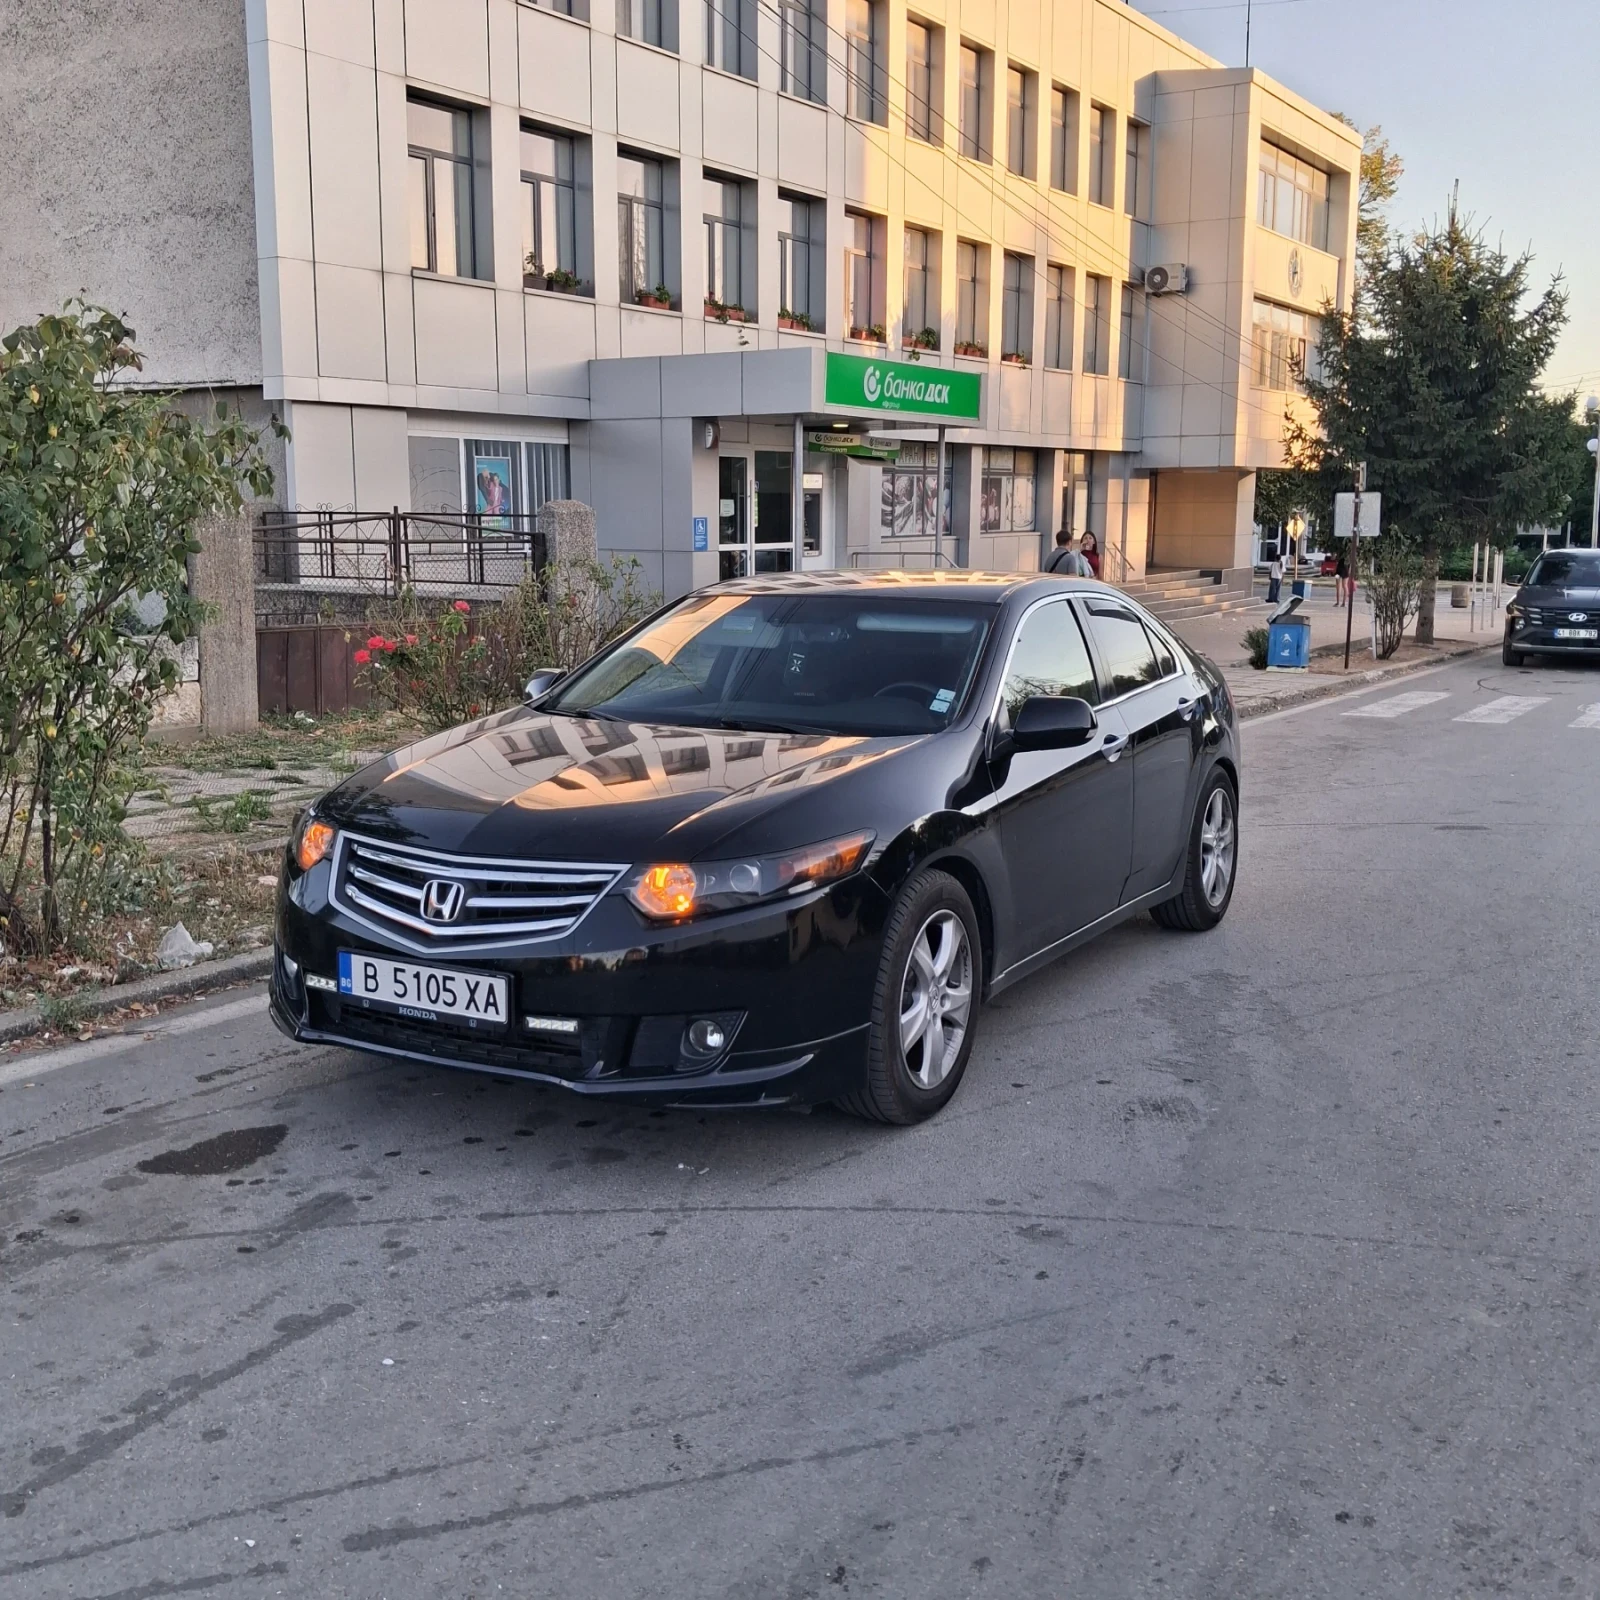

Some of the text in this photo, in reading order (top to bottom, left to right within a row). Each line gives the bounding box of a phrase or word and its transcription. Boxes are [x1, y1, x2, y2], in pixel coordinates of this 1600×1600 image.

[884, 371, 925, 401] банка
[341, 977, 352, 988] BG
[364, 962, 500, 1015] B 5105 XA
[398, 1006, 438, 1021] HONDA
